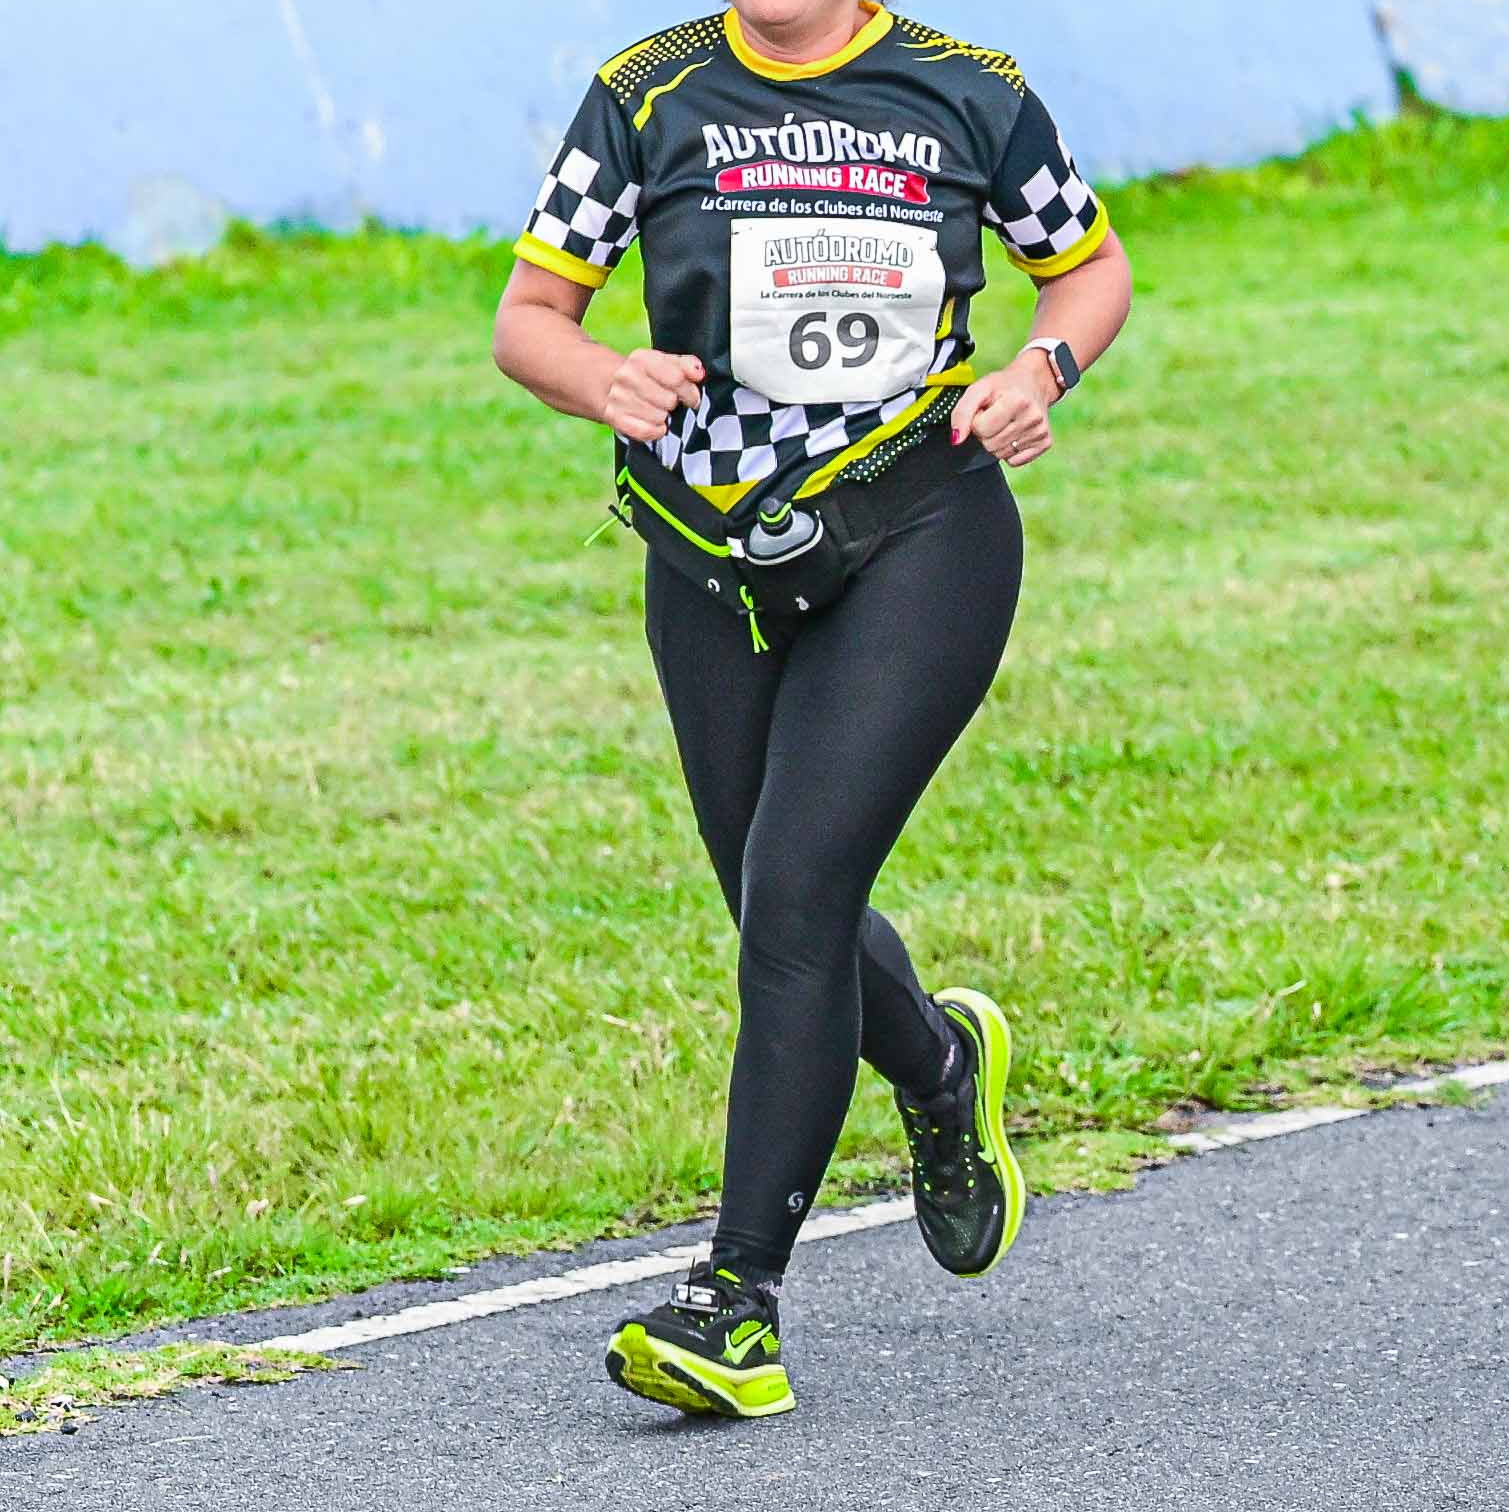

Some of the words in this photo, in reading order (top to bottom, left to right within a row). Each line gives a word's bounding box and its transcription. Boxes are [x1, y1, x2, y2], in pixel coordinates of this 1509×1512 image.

[701, 112, 942, 174] AUTÓDROMO
[741, 163, 842, 189] RUNNING
[848, 166, 908, 198] RACE
[701, 196, 715, 211] La
[715, 196, 766, 212] Carrera
[768, 198, 786, 213] de
[790, 199, 812, 215] los
[814, 200, 863, 217] Clubes
[865, 201, 888, 219] del
[890, 204, 943, 223] Noroeste
[764, 228, 914, 268] AUTÓDROMO
[787, 267, 848, 285] RUNNING
[853, 268, 889, 286] RACE
[760, 290, 770, 300] La
[772, 290, 804, 299] Carrera
[805, 289, 816, 298] de
[818, 289, 830, 297] los
[831, 289, 859, 299] Clubes
[861, 290, 874, 299] del
[788, 311, 880, 371] 69
